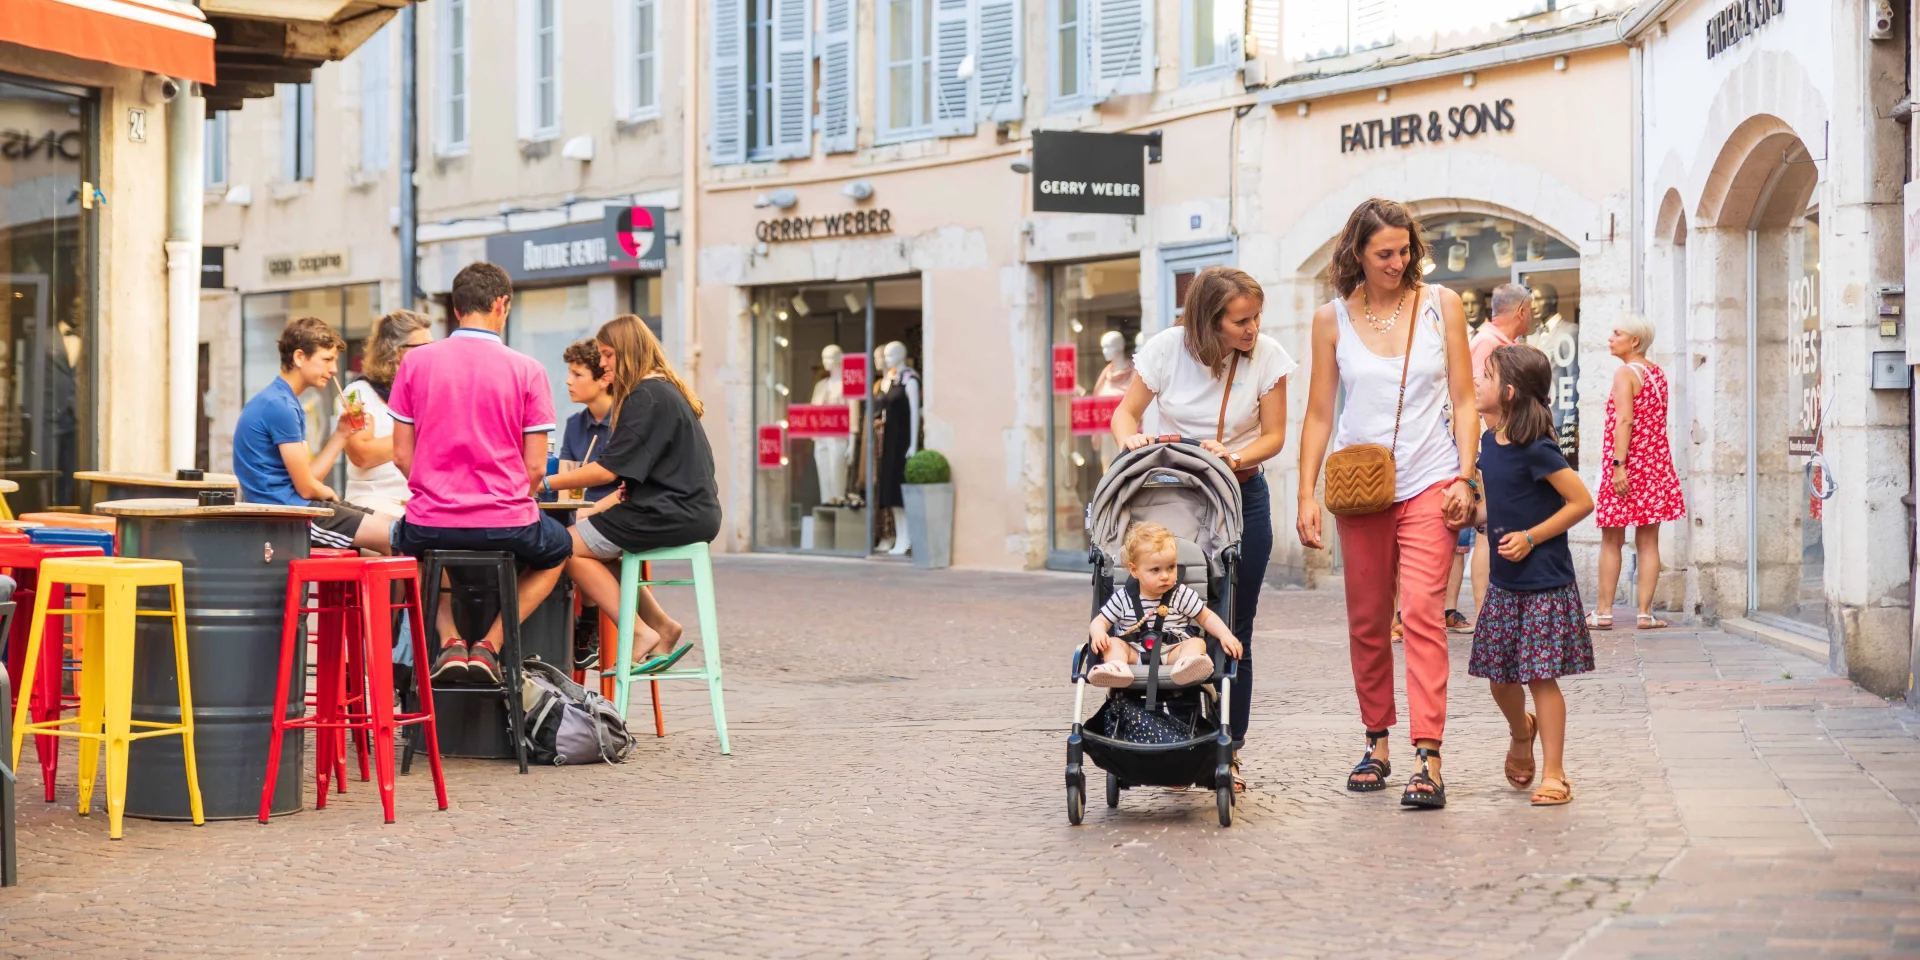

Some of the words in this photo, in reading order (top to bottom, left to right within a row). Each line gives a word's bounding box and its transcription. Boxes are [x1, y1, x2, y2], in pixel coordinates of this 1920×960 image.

[1706, 0, 1742, 60] FATHER
[130, 111, 145, 140] 24
[1341, 113, 1424, 153] FATHER
[1427, 110, 1442, 142] &
[1448, 98, 1515, 139] SONS
[1040, 180, 1087, 195] GERRY
[1091, 182, 1141, 197] WEBER
[755, 216, 814, 243] GERRY
[825, 208, 893, 237] WEBER
[843, 369, 865, 385] 50%
[1055, 361, 1074, 378] 50%
[818, 413, 838, 428] SALE
[1073, 409, 1090, 423] SALE
